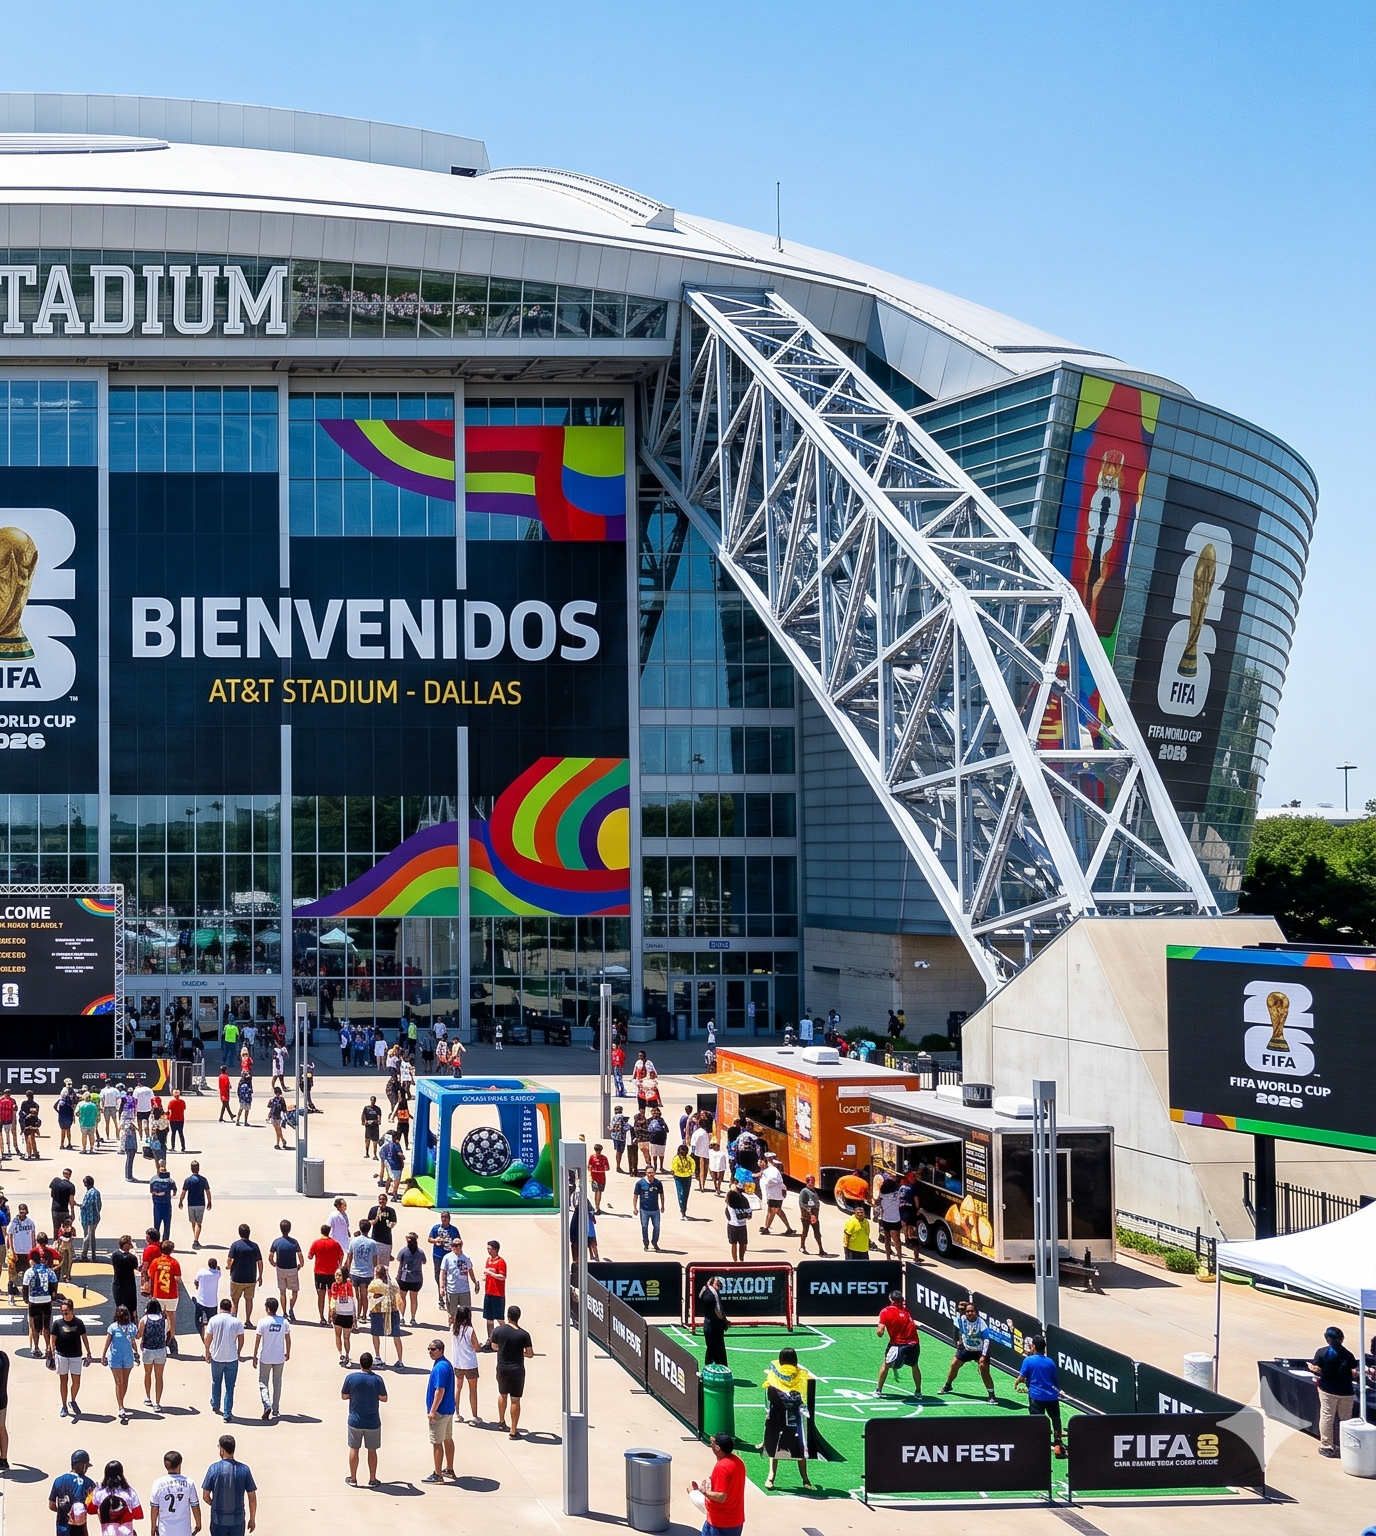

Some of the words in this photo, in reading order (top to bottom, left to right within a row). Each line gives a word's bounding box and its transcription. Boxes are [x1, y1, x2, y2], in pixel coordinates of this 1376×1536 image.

[132, 596, 601, 661] BIENVENIDOS
[208, 678, 275, 703] AT&T
[282, 678, 398, 704] STADIUM
[424, 680, 523, 705] DALLAS
[1169, 682, 1196, 705] FIFA
[43, 715, 77, 728] CUP
[1262, 1053, 1297, 1069] FIFA
[7, 1067, 60, 1084] FEST
[1229, 1076, 1256, 1089] FIFA
[1257, 1079, 1303, 1094] WORLD
[1304, 1085, 1332, 1097] CUP
[1255, 1092, 1304, 1109] 2026
[809, 1281, 843, 1295] FAN
[847, 1281, 889, 1295] FEST
[916, 1282, 952, 1320] FIFA
[1058, 1351, 1084, 1378] FAN
[1086, 1364, 1119, 1393] FEST
[901, 1445, 949, 1463] FAN
[956, 1444, 1015, 1462] FEST
[1113, 1434, 1195, 1459] FIFA
